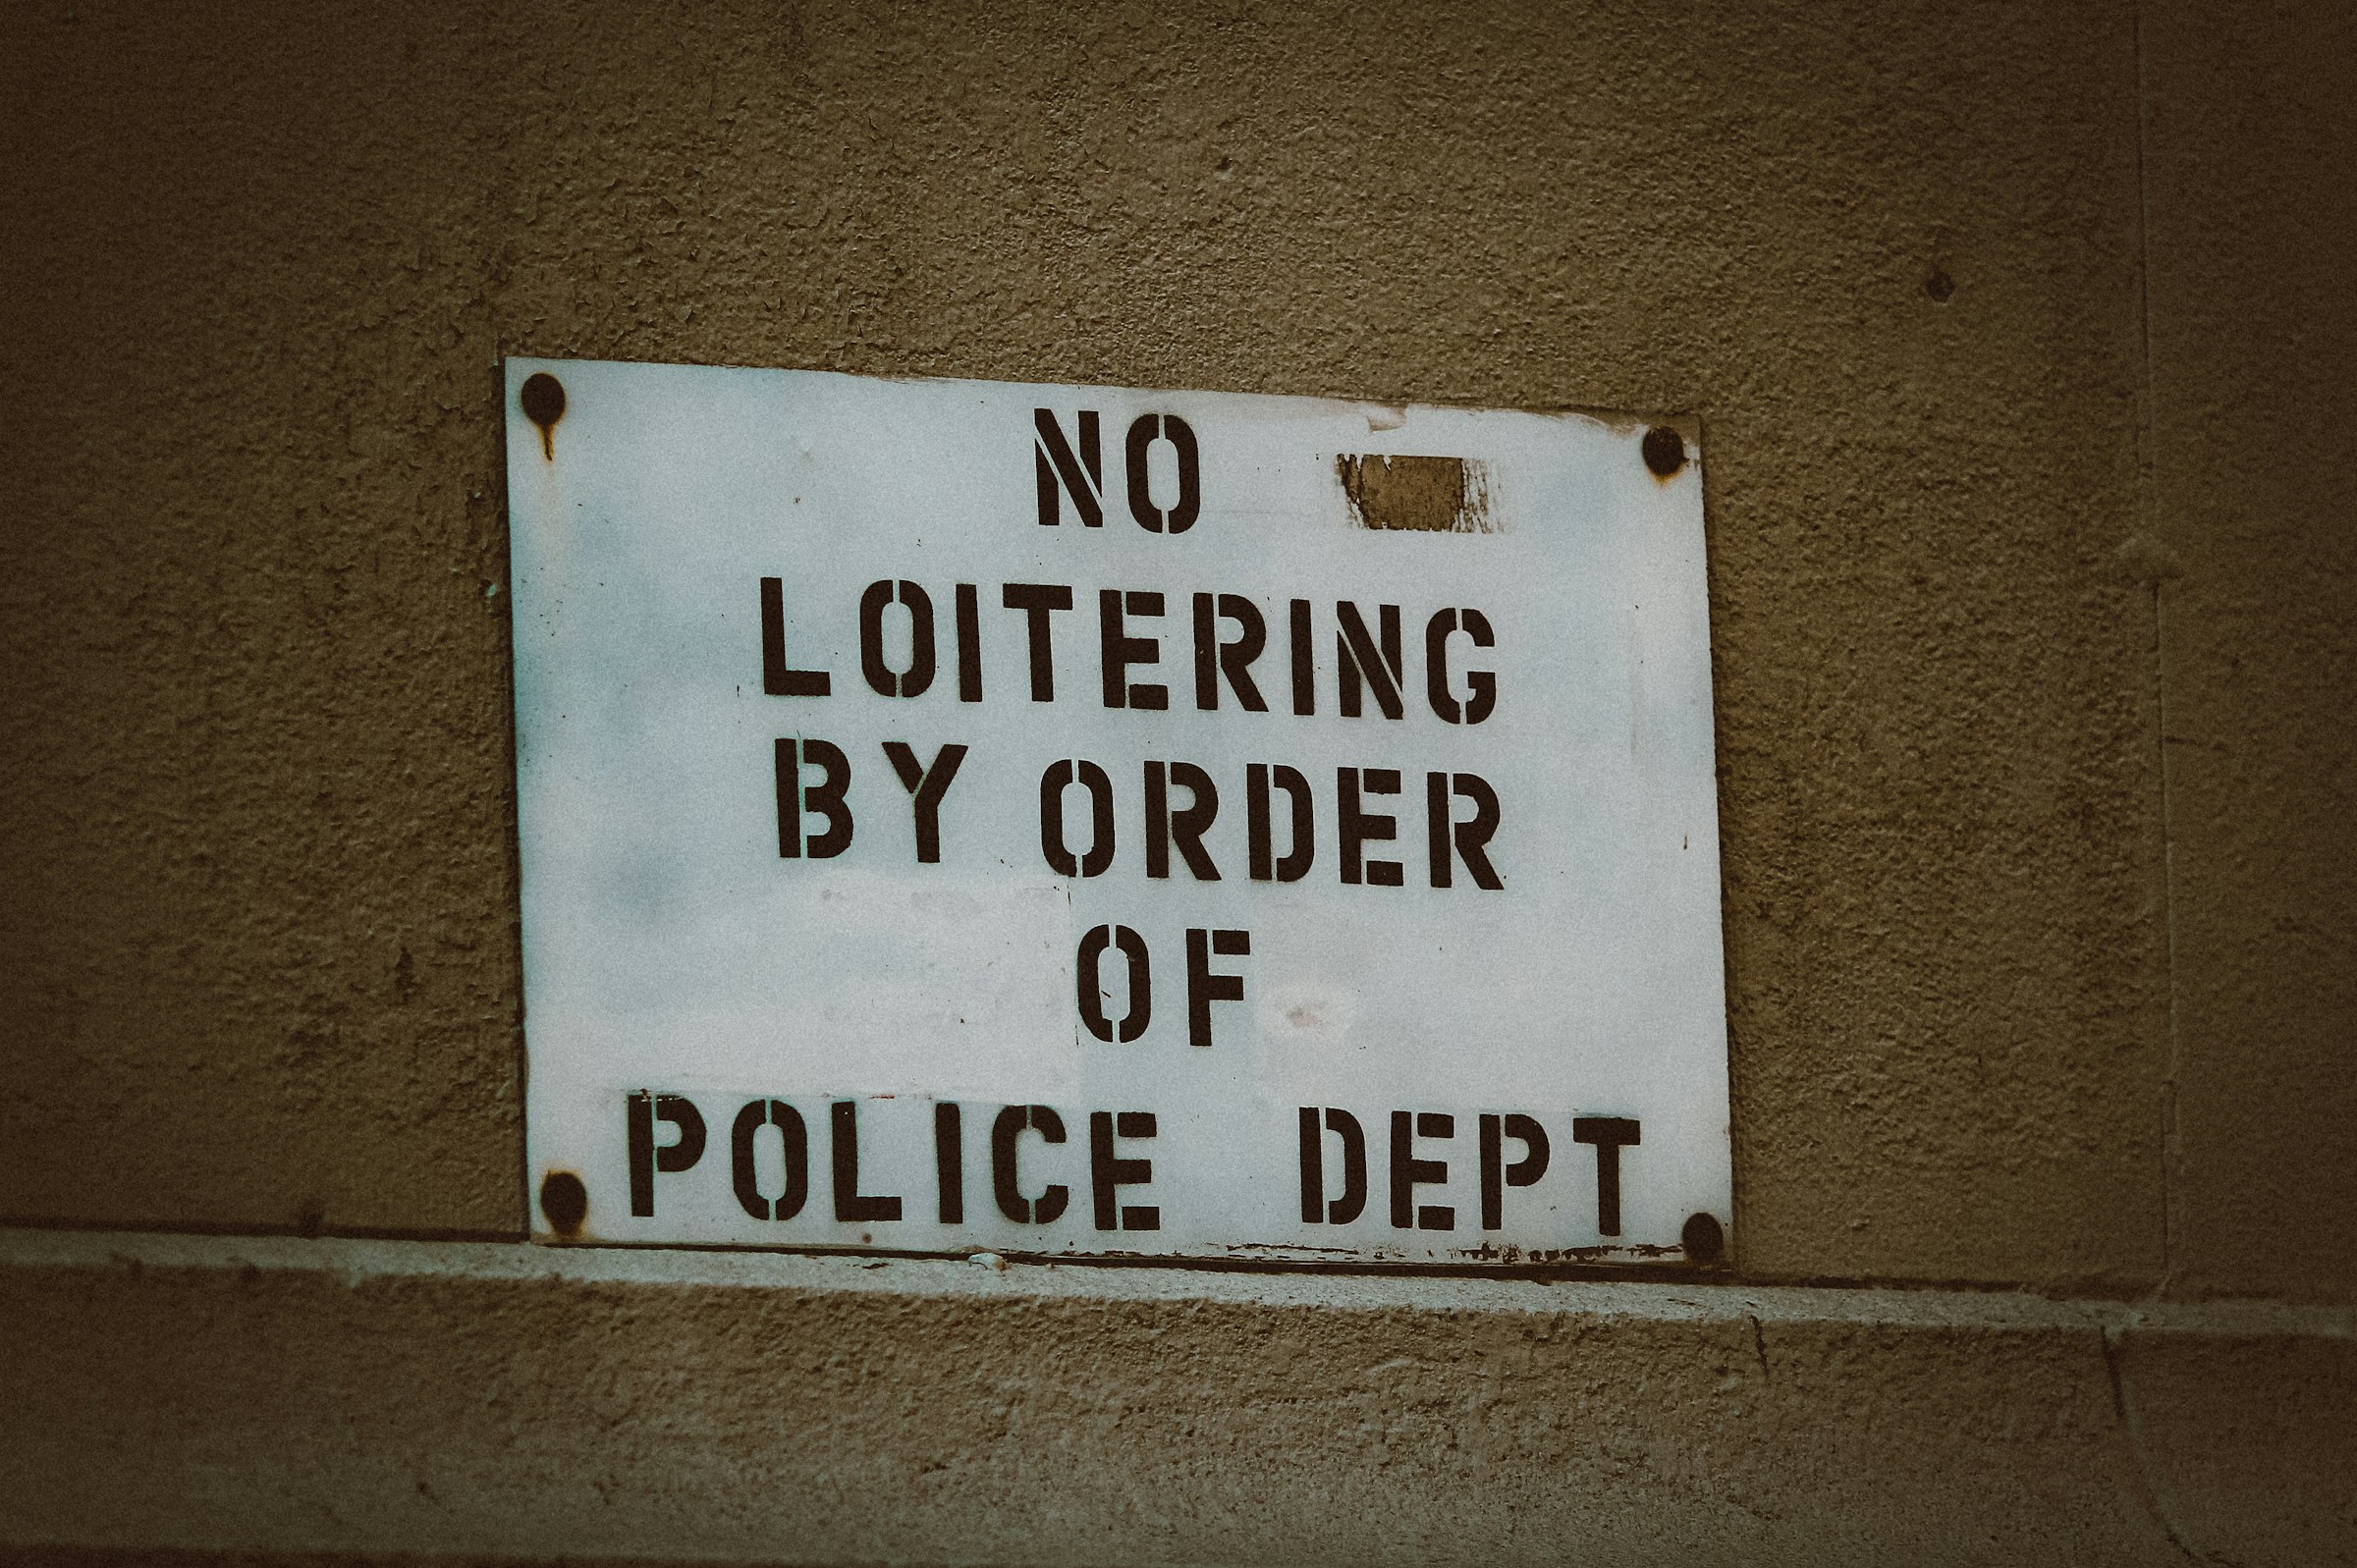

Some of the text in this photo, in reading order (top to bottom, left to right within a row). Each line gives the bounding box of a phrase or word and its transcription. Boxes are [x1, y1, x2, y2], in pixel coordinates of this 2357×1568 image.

[1034, 407, 1201, 534] NO
[760, 576, 1497, 726] LOITERING
[774, 737, 1505, 891] BY ORDER
[1077, 924, 1251, 1048] OF
[627, 1090, 1642, 1238] POLICE DEPT
